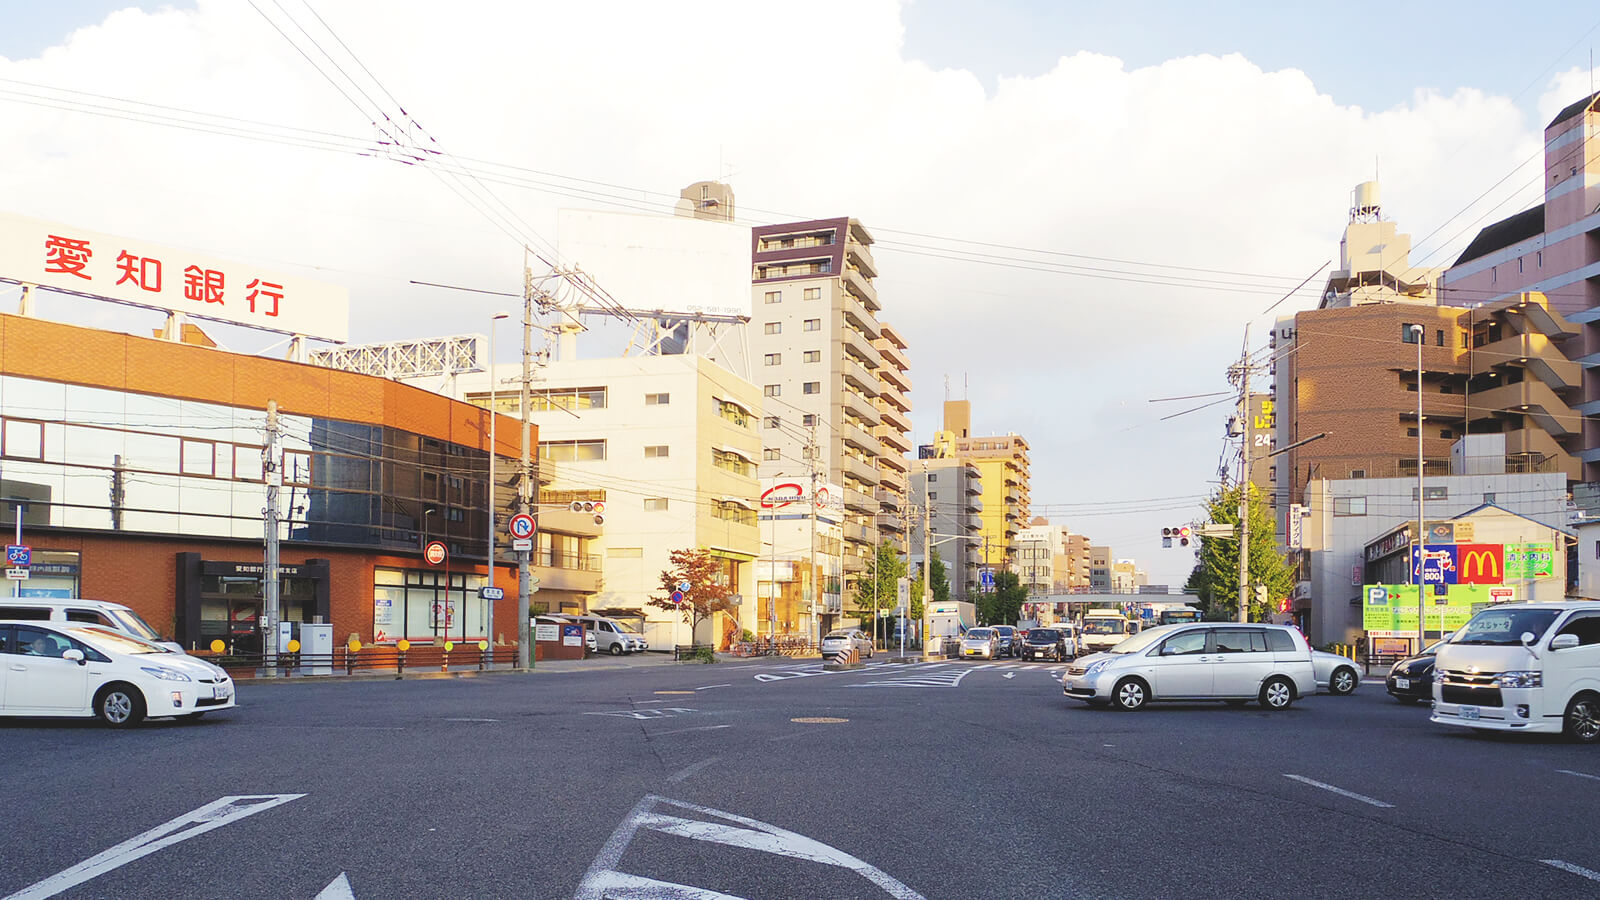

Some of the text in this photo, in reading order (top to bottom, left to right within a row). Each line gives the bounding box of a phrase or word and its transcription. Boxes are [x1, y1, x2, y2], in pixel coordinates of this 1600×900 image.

[45, 234, 284, 317] 愛知銀行
[1254, 433, 1271, 447] 24
